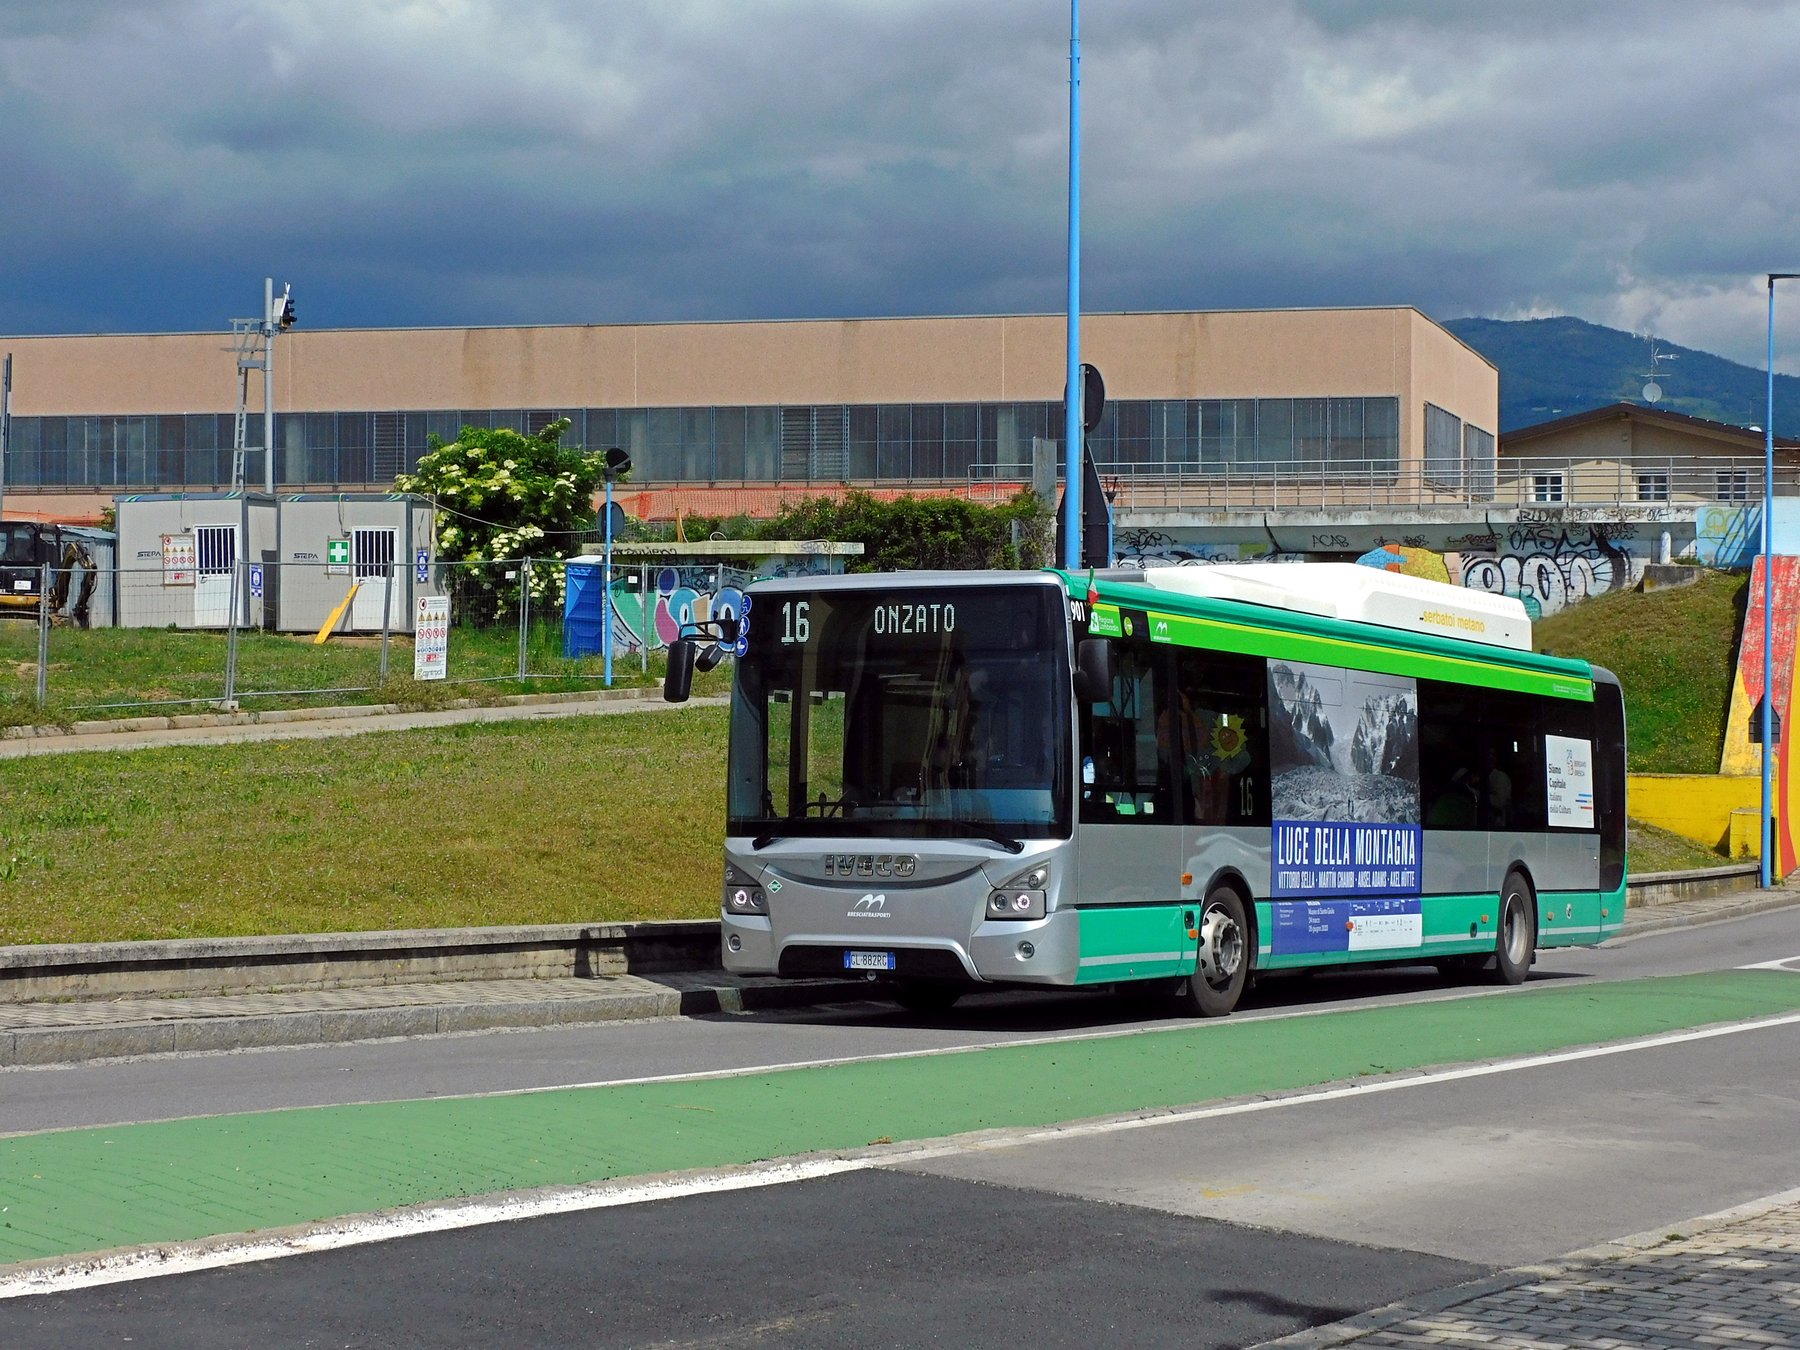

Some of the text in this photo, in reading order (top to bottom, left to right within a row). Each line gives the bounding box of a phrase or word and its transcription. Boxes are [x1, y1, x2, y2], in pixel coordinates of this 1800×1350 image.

[1312, 534, 1350, 548] ACAB
[781, 601, 810, 643] 16
[874, 603, 955, 634] ONZATO
[1070, 600, 1086, 622] 901
[1423, 610, 1485, 633] serbatoi metano
[1240, 777, 1253, 816] 16
[1278, 826, 1416, 865] LUCE DELLA MONTAGNA
[824, 854, 916, 878] IVECO
